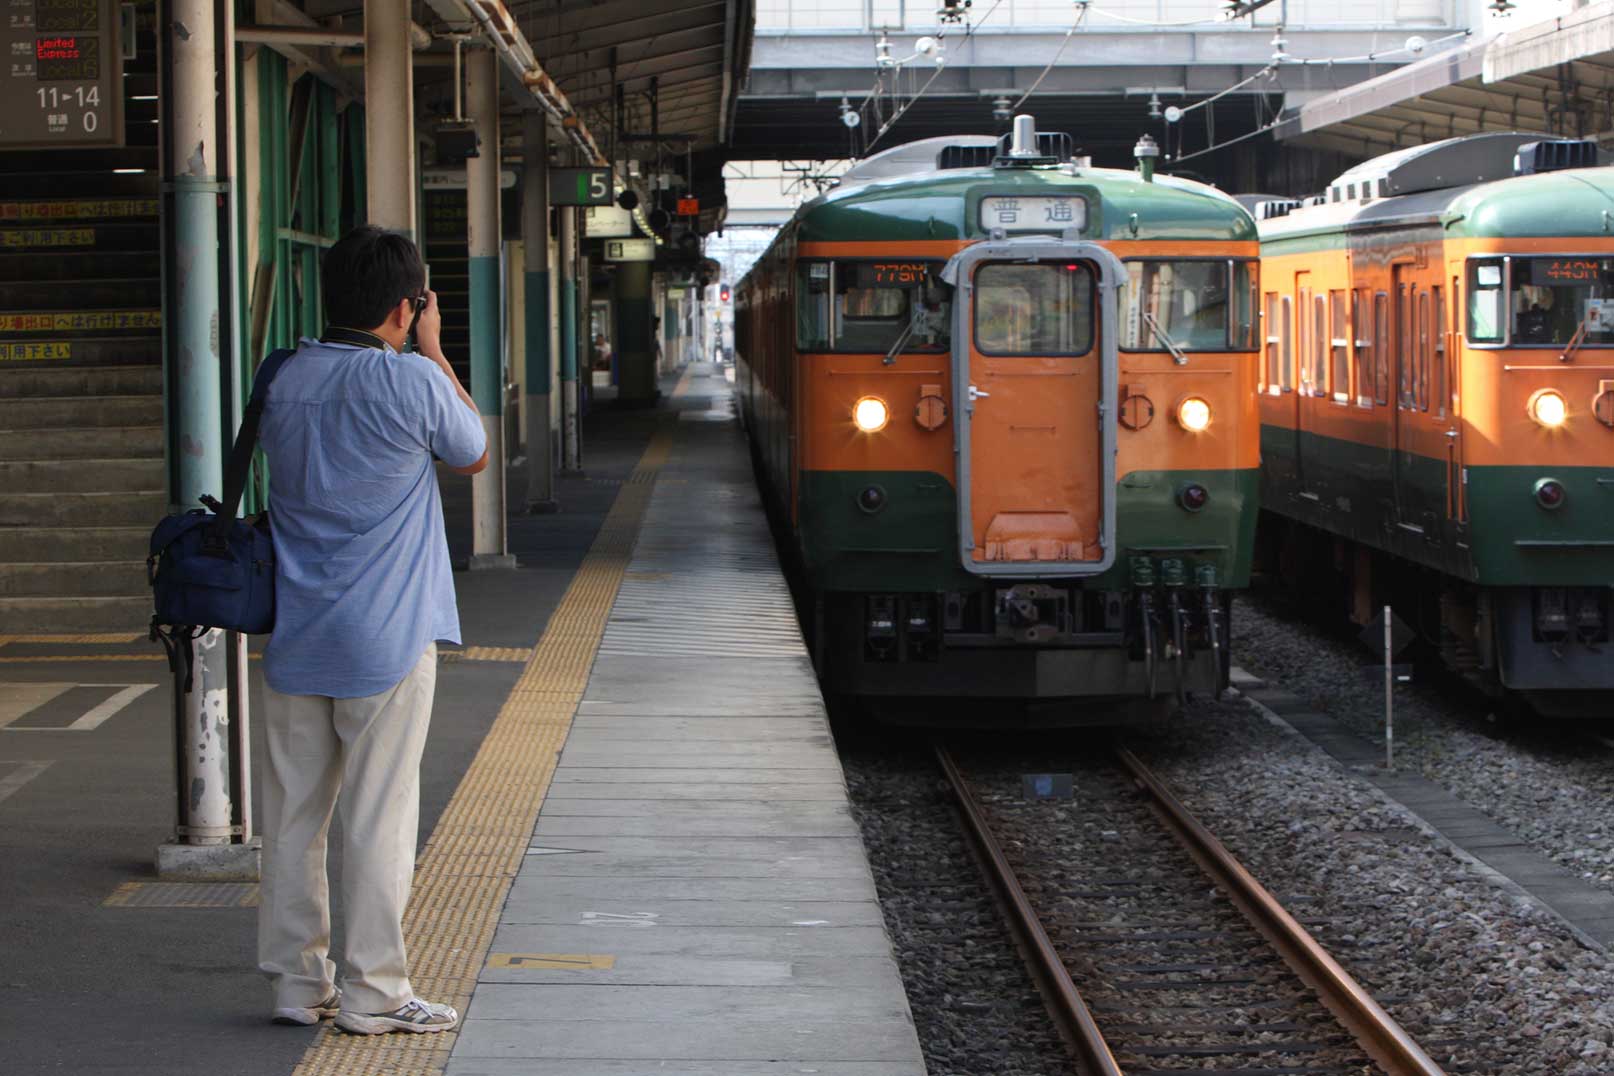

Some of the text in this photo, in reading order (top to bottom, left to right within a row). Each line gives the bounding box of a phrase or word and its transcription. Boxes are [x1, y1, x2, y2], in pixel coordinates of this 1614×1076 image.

[37, 38, 75, 48] Limited
[37, 49, 79, 59] Express
[83, 111, 97, 132] 0
[590, 173, 607, 199] 5
[993, 197, 1074, 224] 普通
